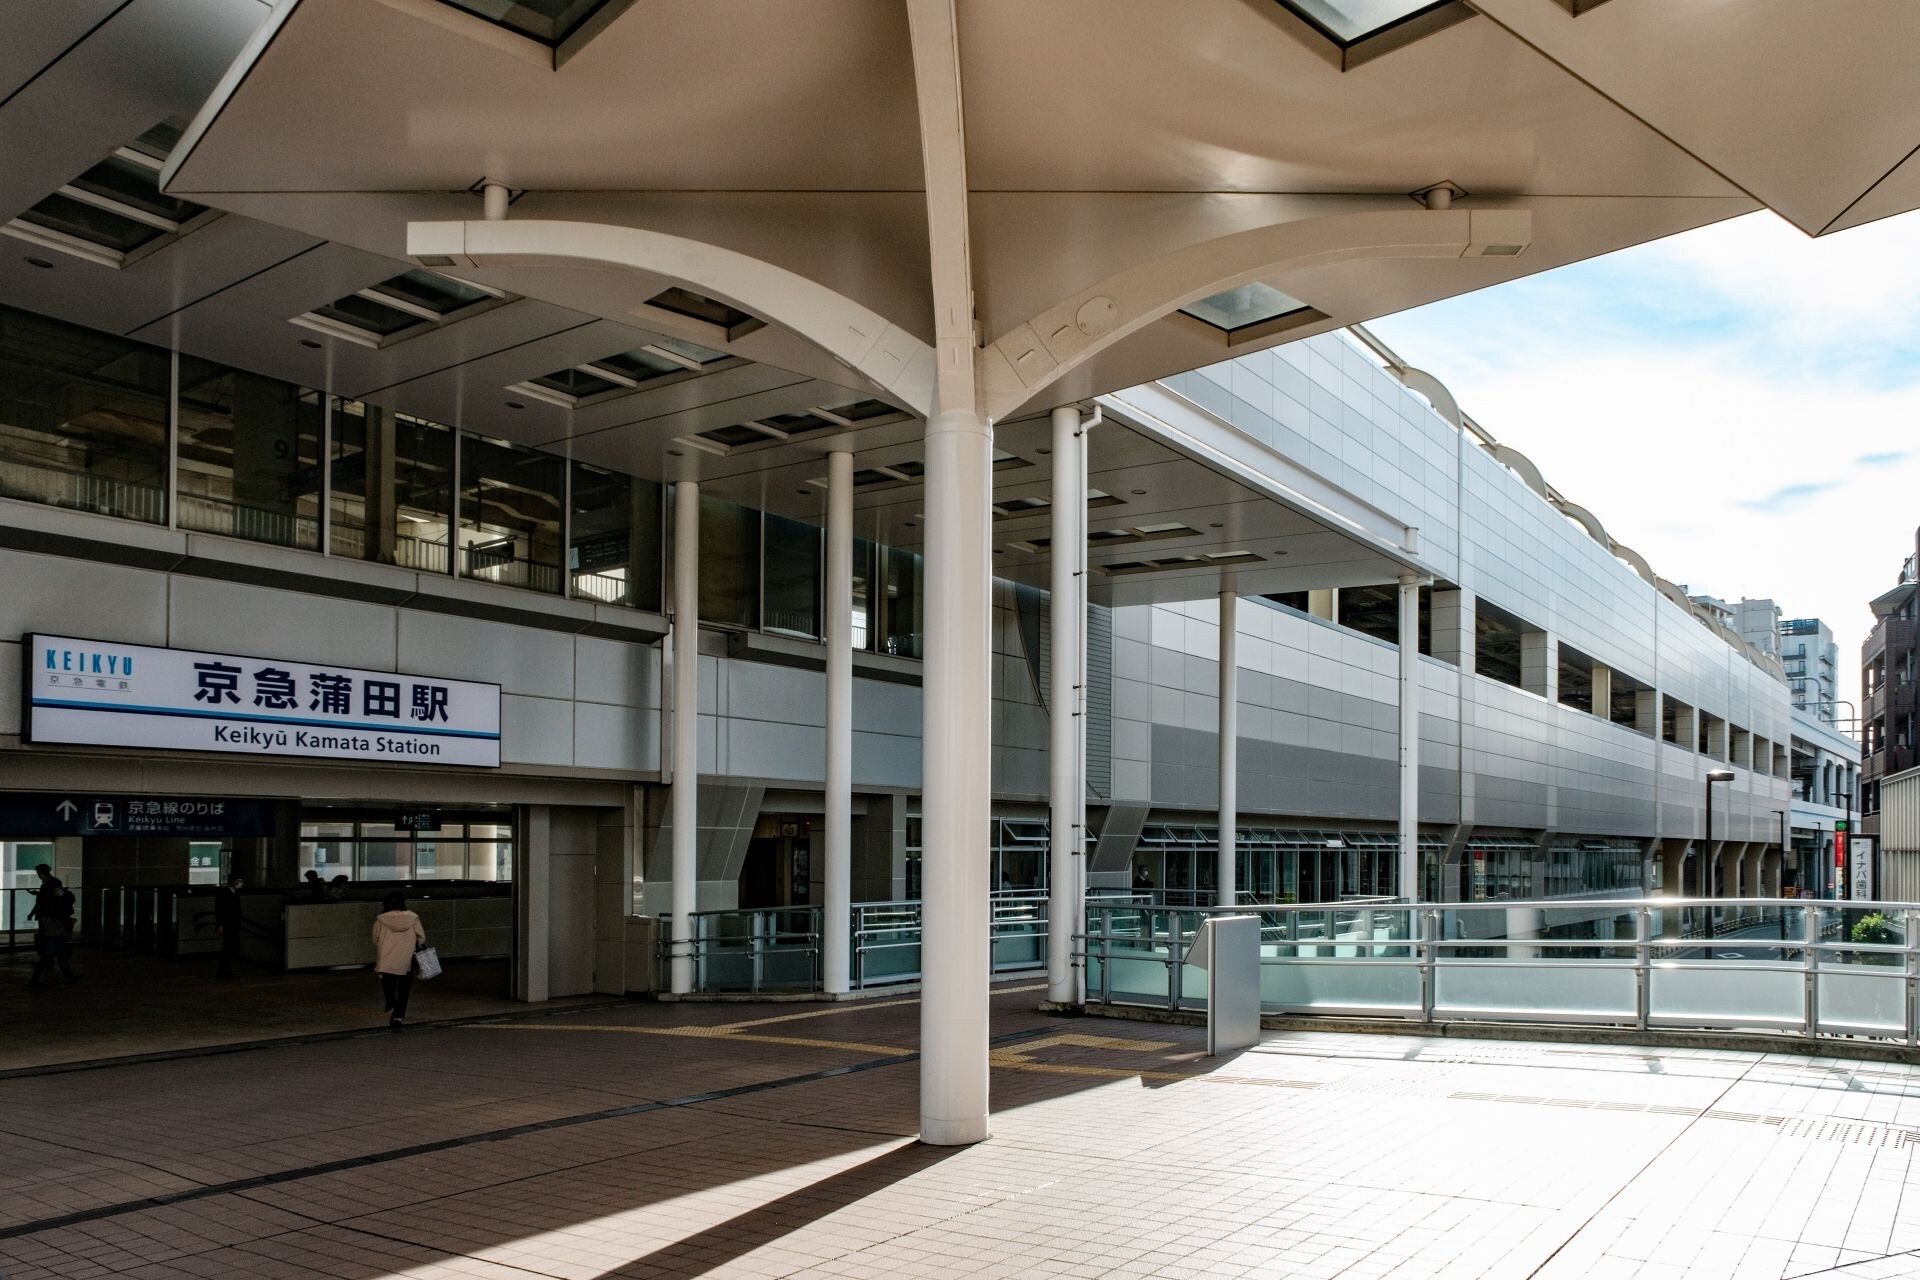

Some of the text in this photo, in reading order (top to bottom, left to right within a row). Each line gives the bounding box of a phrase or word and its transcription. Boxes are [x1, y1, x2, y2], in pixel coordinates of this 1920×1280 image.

[274, 440, 288, 459] 9
[46, 649, 132, 676] KEIKYU
[193, 660, 449, 723] 京急蒲田駅
[214, 725, 441, 756] Keikyū Kamata Station
[128, 801, 225, 815] 京急線のりば
[165, 815, 186, 824] Line
[1856, 851, 1867, 899] イナバ歯科
